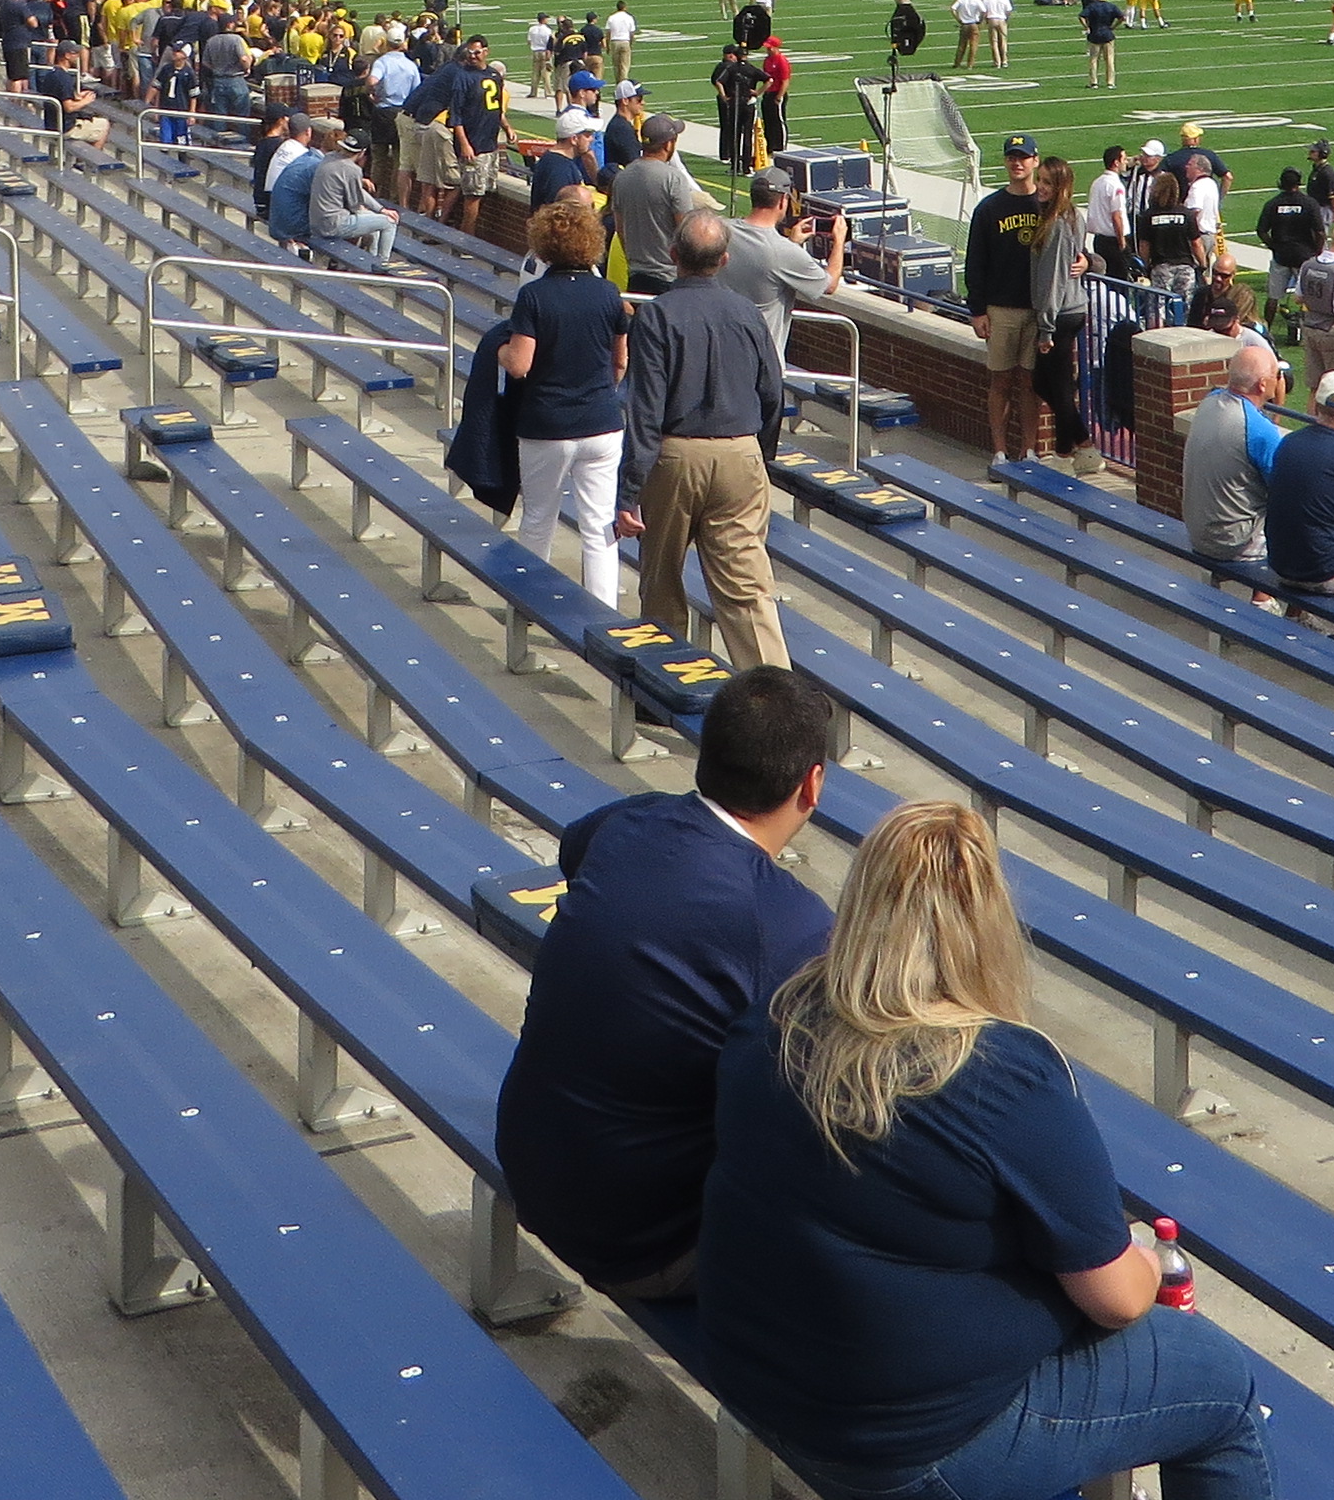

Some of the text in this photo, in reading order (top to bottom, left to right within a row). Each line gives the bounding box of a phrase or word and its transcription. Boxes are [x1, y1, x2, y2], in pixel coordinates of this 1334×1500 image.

[168, 76, 177, 99] 1
[481, 78, 500, 111] 2
[1011, 136, 1025, 145] M
[998, 213, 1044, 234] MICHIG
[1151, 213, 1185, 226] ESPN
[855, 490, 908, 506] M
[607, 623, 673, 649] M
[662, 658, 733, 685] M
[180, 1108, 200, 1117] 6
[399, 1365, 423, 1379] 8
